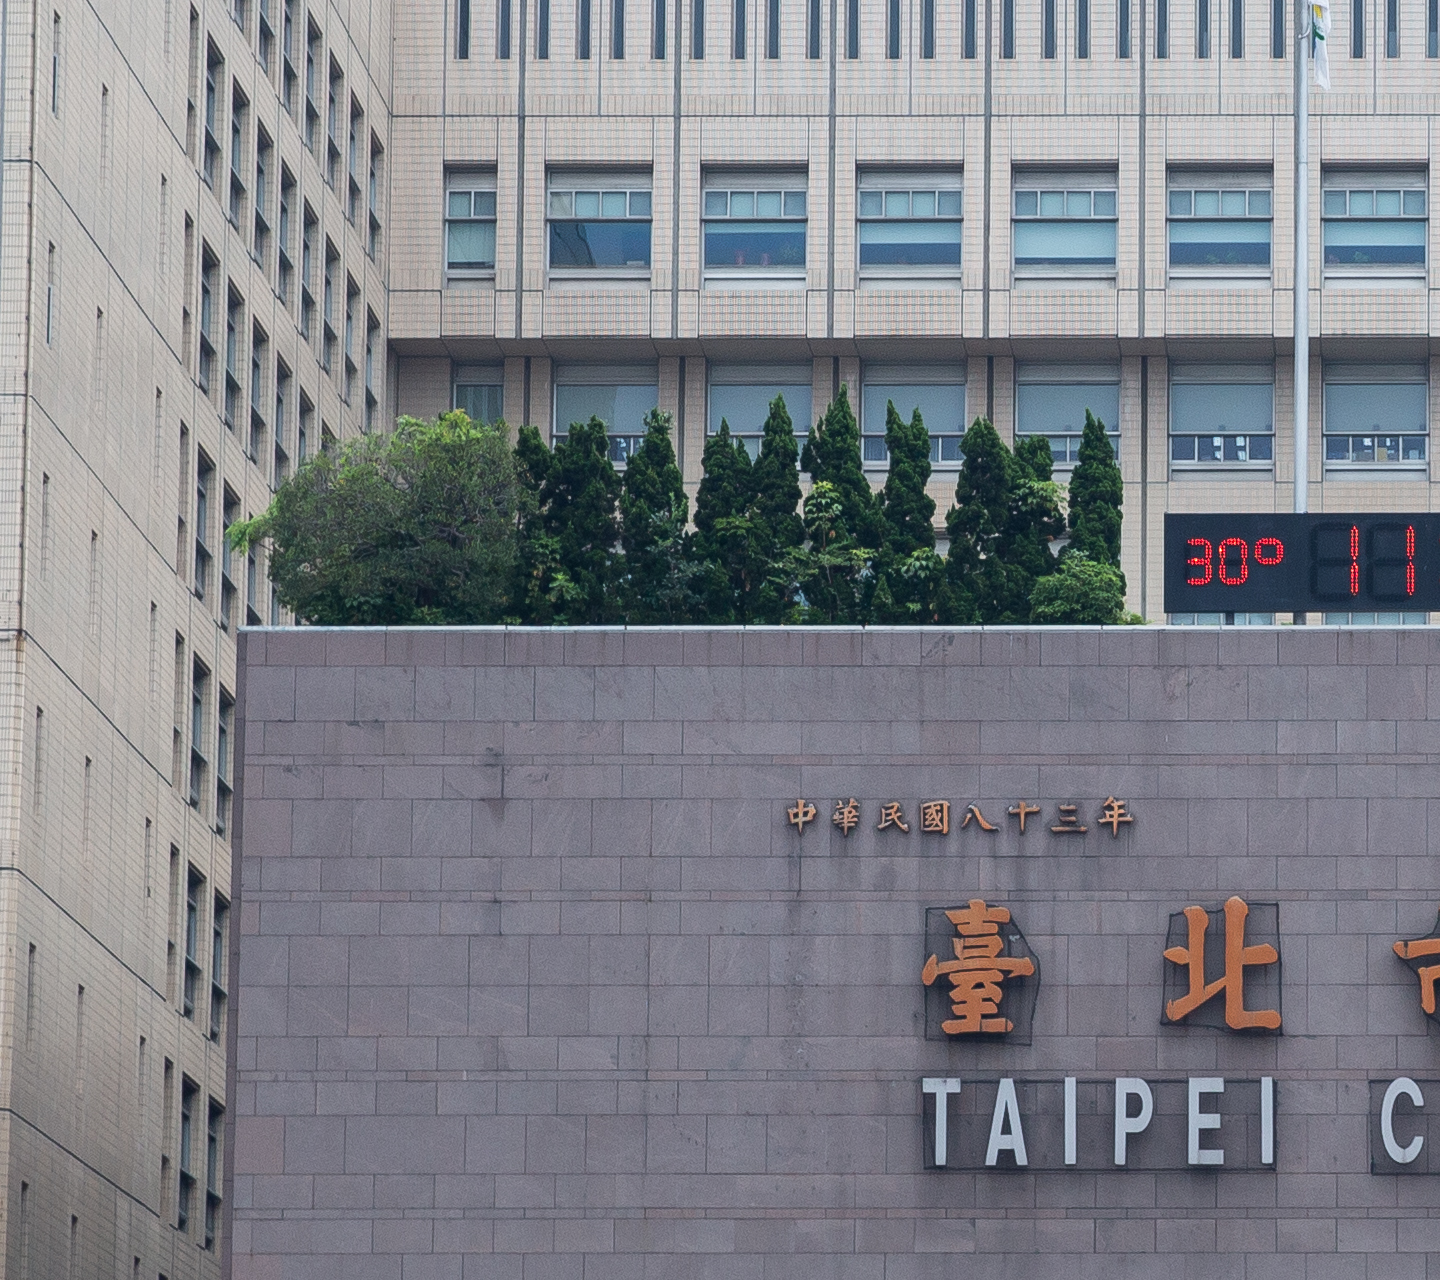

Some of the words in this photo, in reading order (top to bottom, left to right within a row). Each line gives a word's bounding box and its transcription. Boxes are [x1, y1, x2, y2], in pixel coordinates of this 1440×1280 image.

[785, 796, 1135, 838] 中華民國八十三年
[921, 1076, 1275, 1167] TAIPEI
